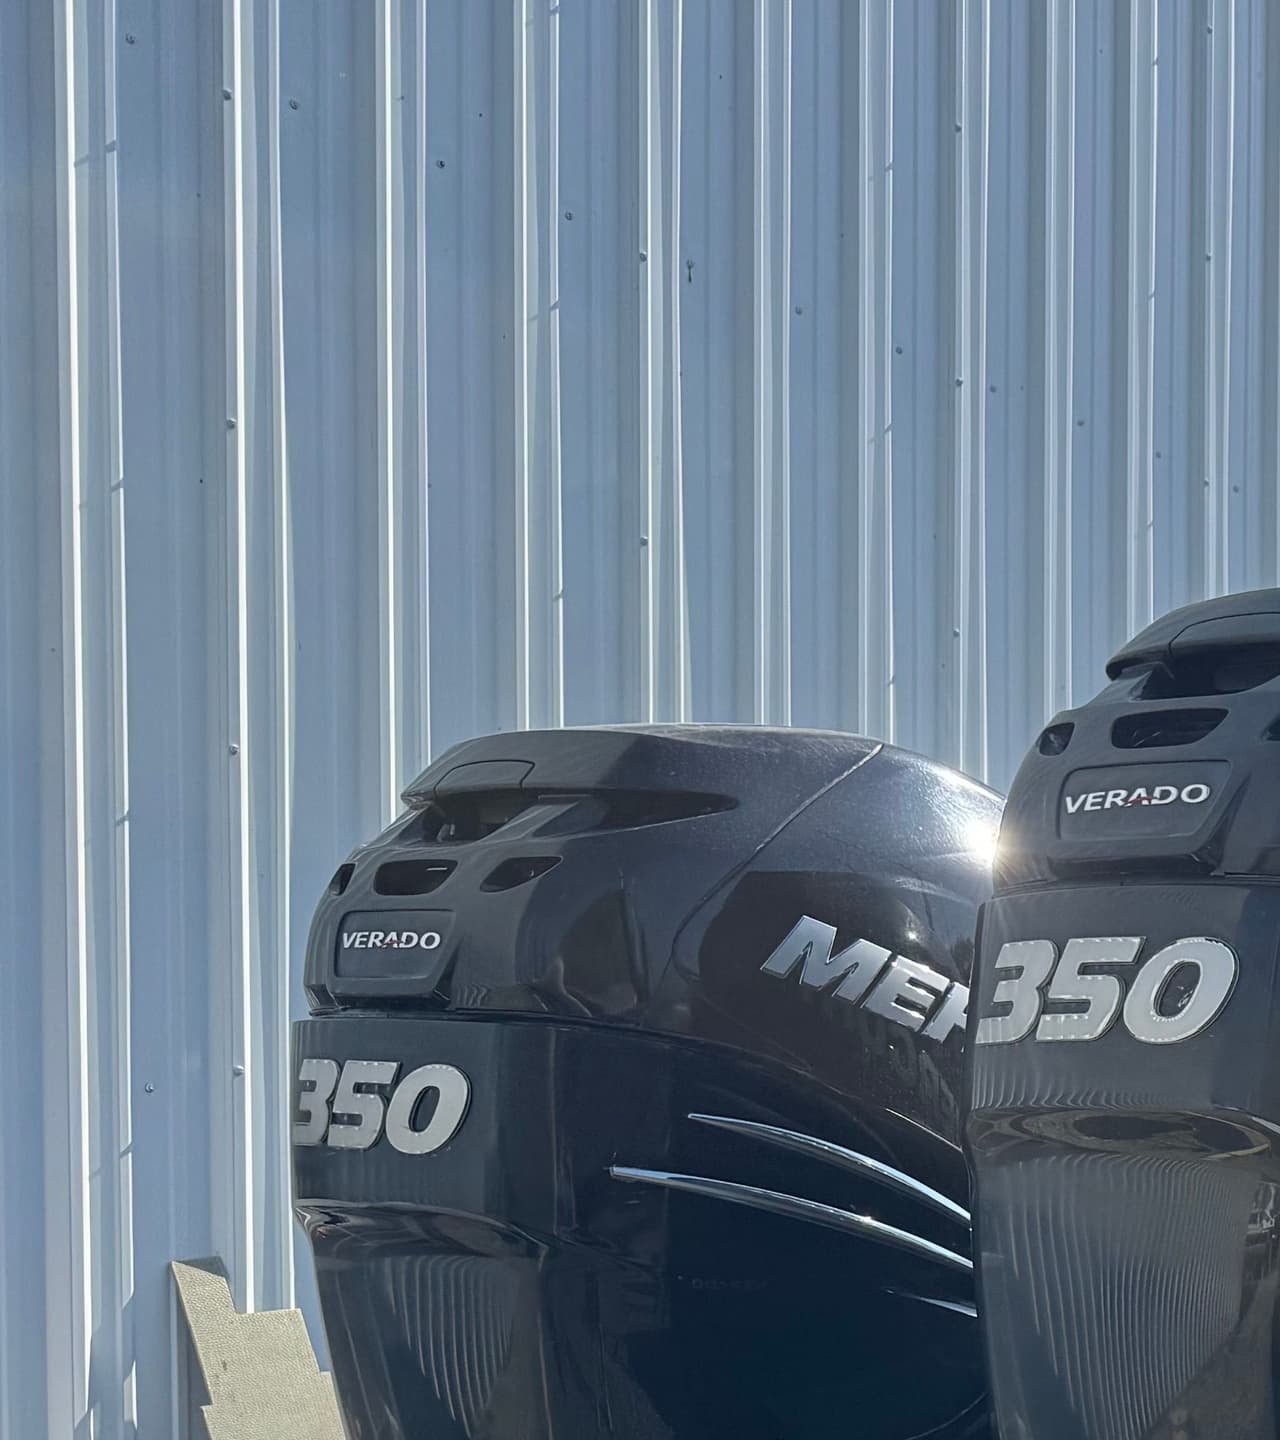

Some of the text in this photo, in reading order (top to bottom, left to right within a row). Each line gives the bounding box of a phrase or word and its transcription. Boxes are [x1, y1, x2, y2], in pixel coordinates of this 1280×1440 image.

[1065, 783, 1210, 814] VERADO
[342, 931, 441, 950] VERADO
[975, 936, 1240, 1045] 350
[292, 1058, 472, 1155] 350
